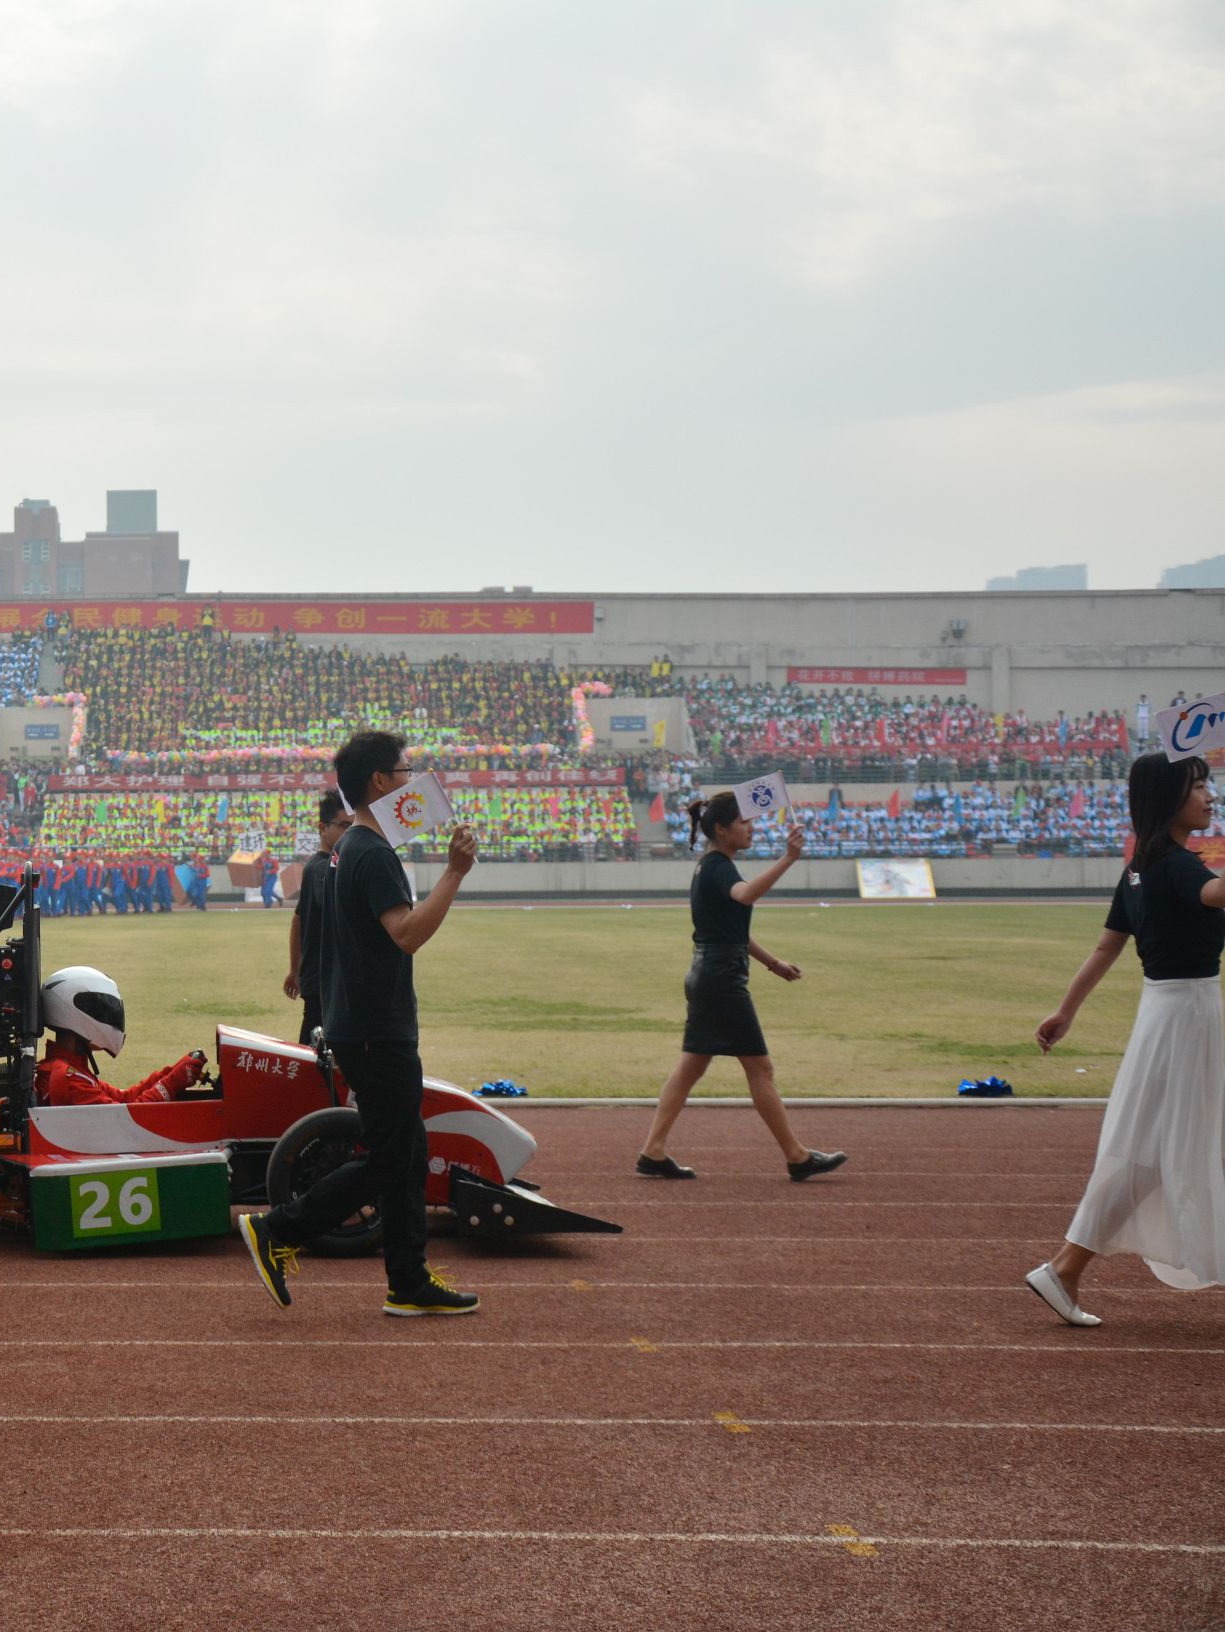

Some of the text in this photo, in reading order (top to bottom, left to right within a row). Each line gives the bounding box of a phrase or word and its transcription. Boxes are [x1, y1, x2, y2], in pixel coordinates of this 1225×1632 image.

[63, 775, 185, 787] 郑大护理
[207, 774, 327, 786] 自强不息
[236, 1051, 301, 1080] 郑州大学
[78, 1176, 153, 1230] 26
